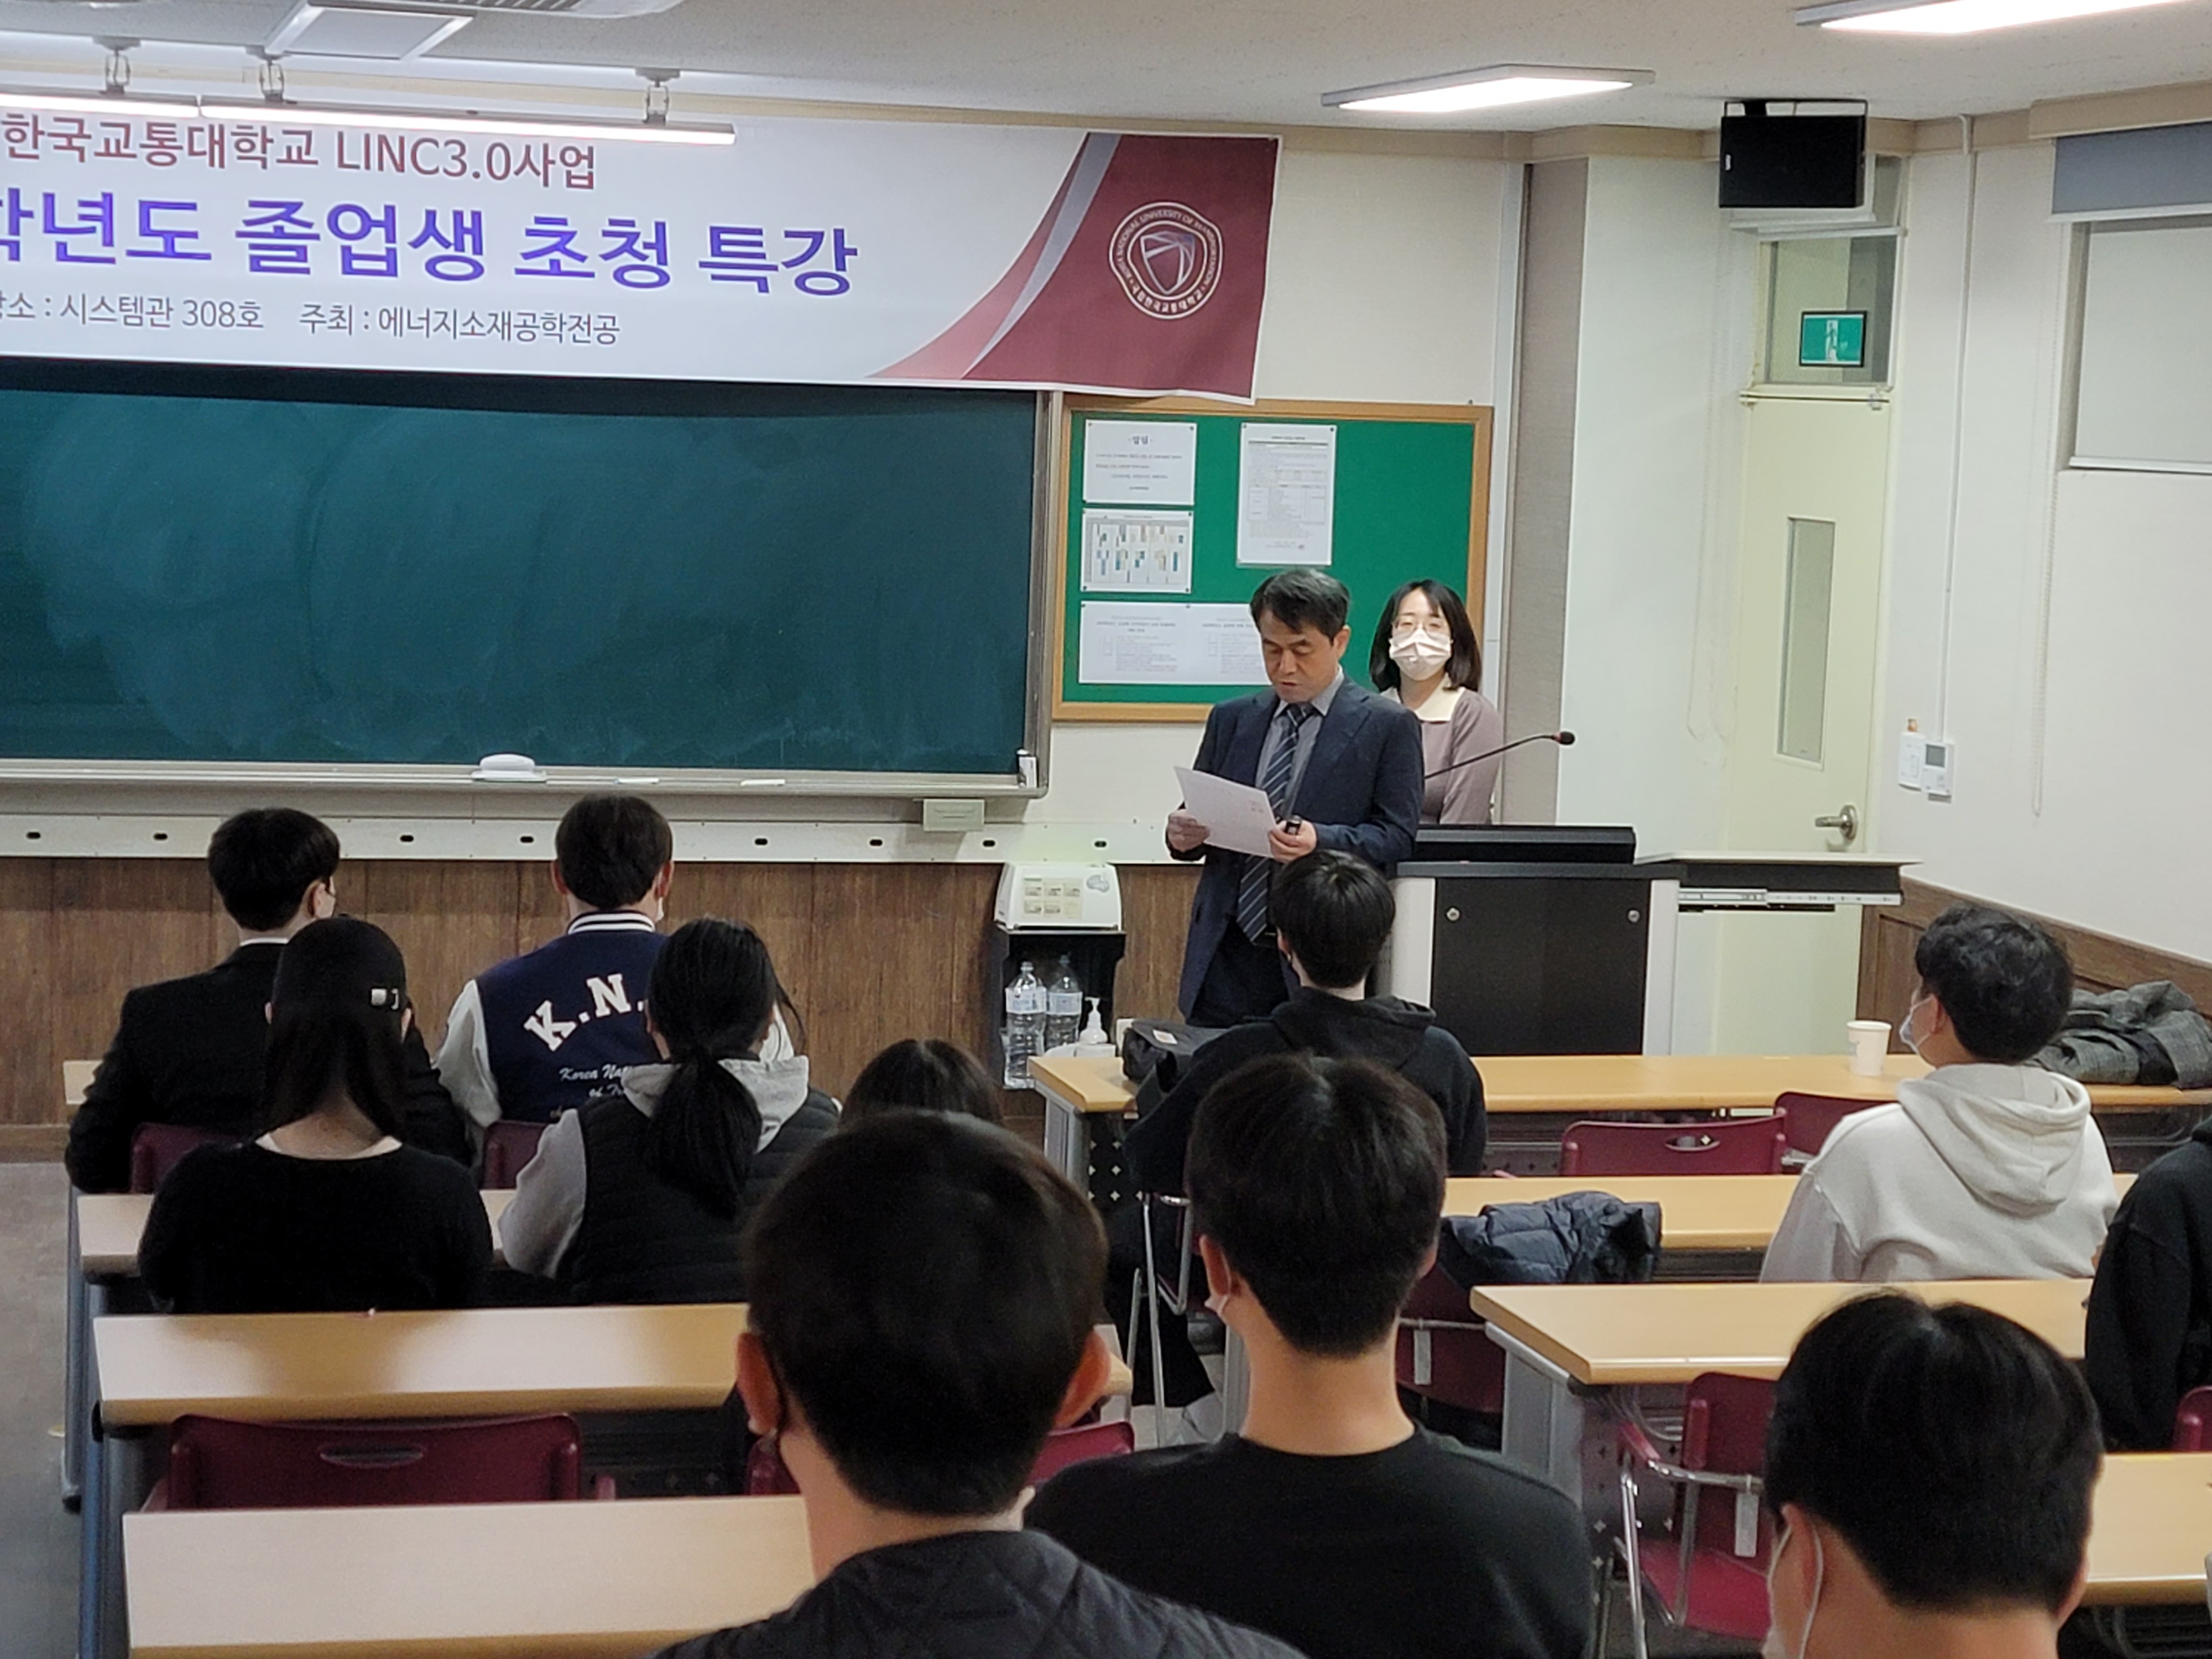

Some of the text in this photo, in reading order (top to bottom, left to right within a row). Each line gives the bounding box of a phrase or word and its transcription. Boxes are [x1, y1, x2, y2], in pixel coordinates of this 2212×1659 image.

[2, 114, 595, 190] 한국교통대학교 LINC3.0사업
[234, 200, 485, 281] 졸업생
[514, 216, 671, 289] 초청
[698, 226, 858, 296] 특강
[60, 293, 174, 328] 시스템관
[182, 299, 264, 328] 308호
[299, 304, 353, 336] 주최
[379, 306, 620, 345] 에너지소재공학전공
[559, 1066, 598, 1081] Korea
